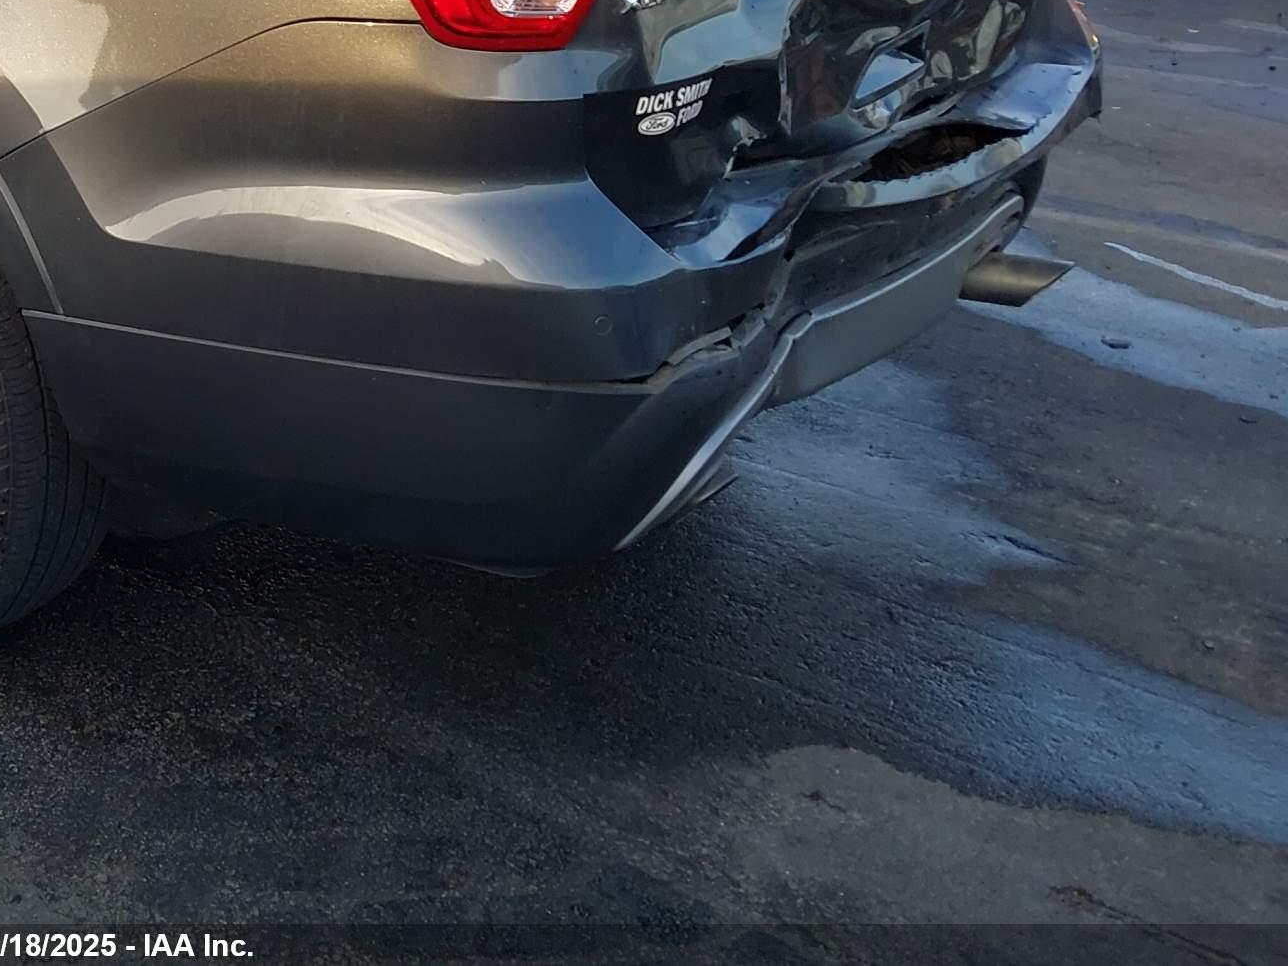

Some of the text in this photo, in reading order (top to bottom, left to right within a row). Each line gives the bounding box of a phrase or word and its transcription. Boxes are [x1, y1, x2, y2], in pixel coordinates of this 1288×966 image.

[636, 78, 713, 115] DICK SMITH
[676, 100, 704, 127] FORD
